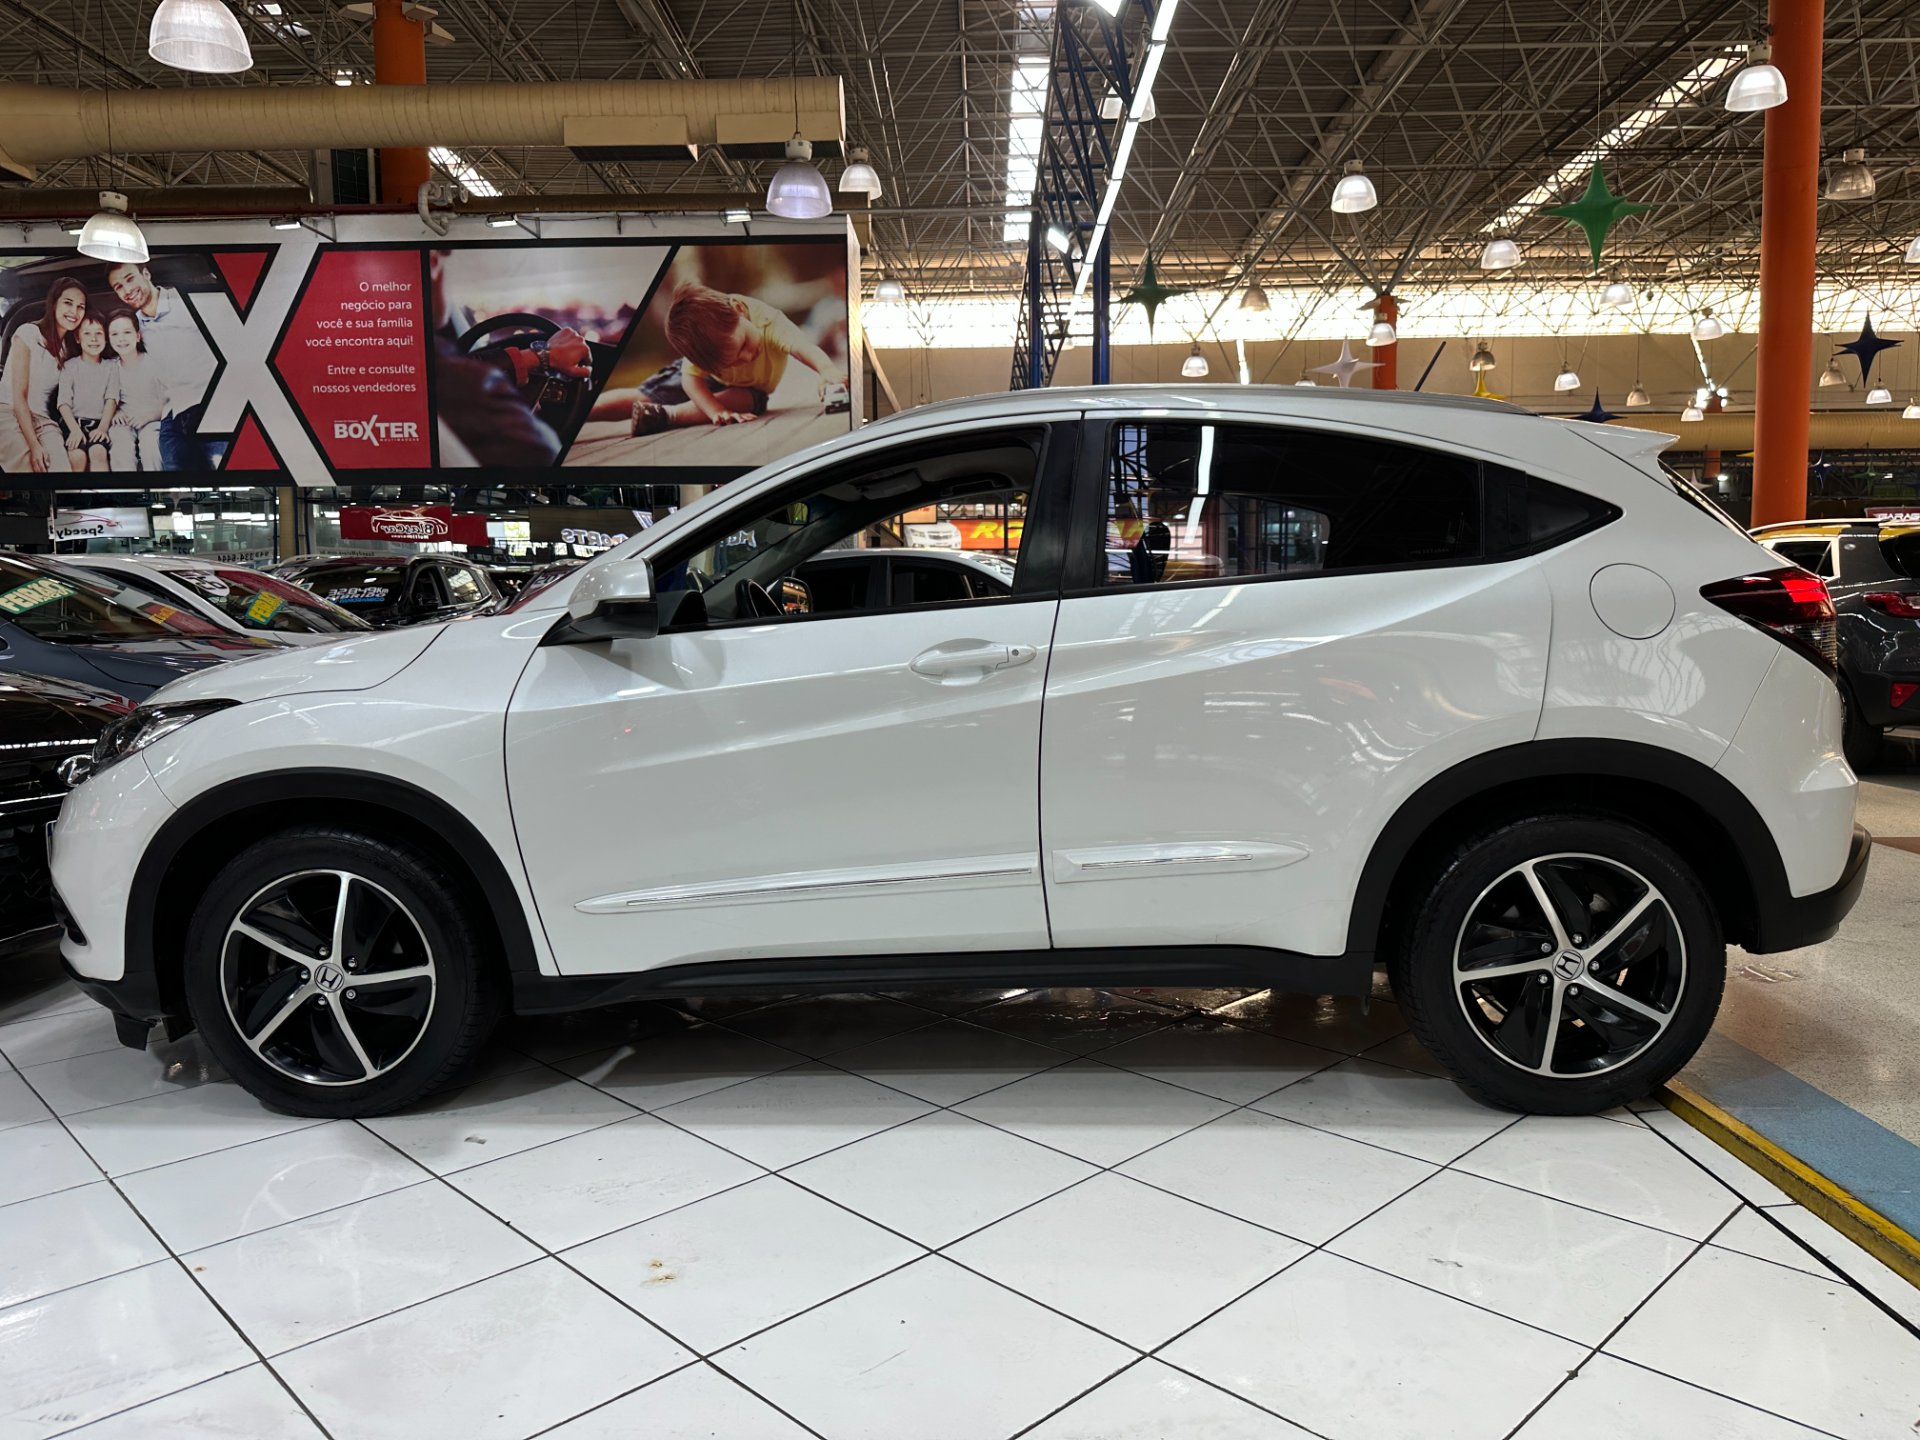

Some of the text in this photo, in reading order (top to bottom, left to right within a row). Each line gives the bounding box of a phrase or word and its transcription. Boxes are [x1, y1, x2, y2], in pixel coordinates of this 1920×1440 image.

[359, 281, 412, 292] O melhor
[341, 300, 413, 313] negócio para
[316, 317, 413, 329] você e sua família
[305, 335, 414, 348] você encontra aqui!
[327, 364, 416, 375] Entre e consulte
[312, 382, 417, 394] nossos vendedores
[333, 414, 420, 446] BOXTER
